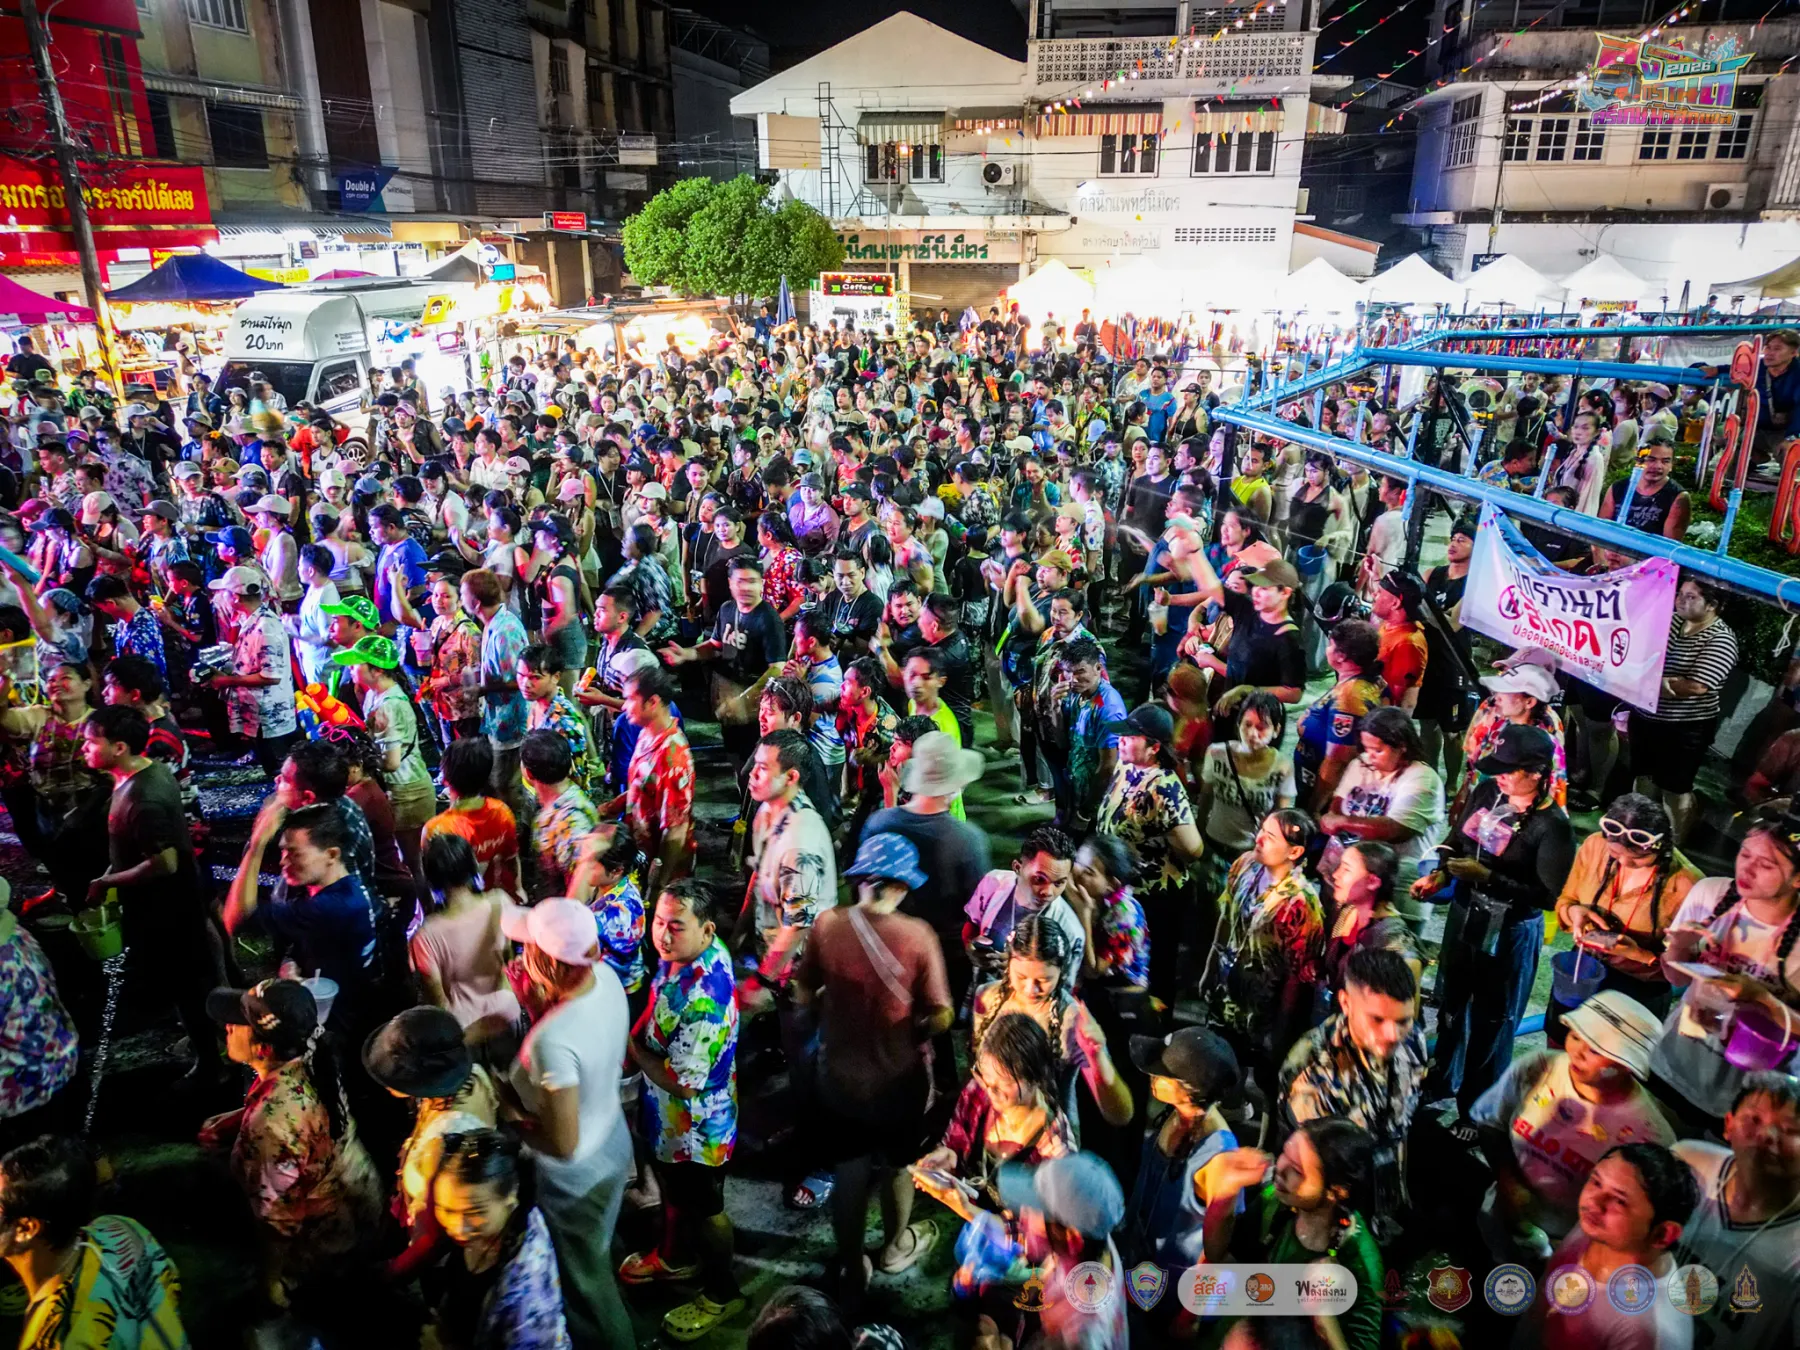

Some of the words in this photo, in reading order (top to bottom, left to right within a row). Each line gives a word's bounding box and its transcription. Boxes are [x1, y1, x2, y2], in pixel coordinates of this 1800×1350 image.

[345, 179, 370, 192] Double
[370, 181, 376, 192] A
[1507, 562, 1623, 621] งกรานต์
